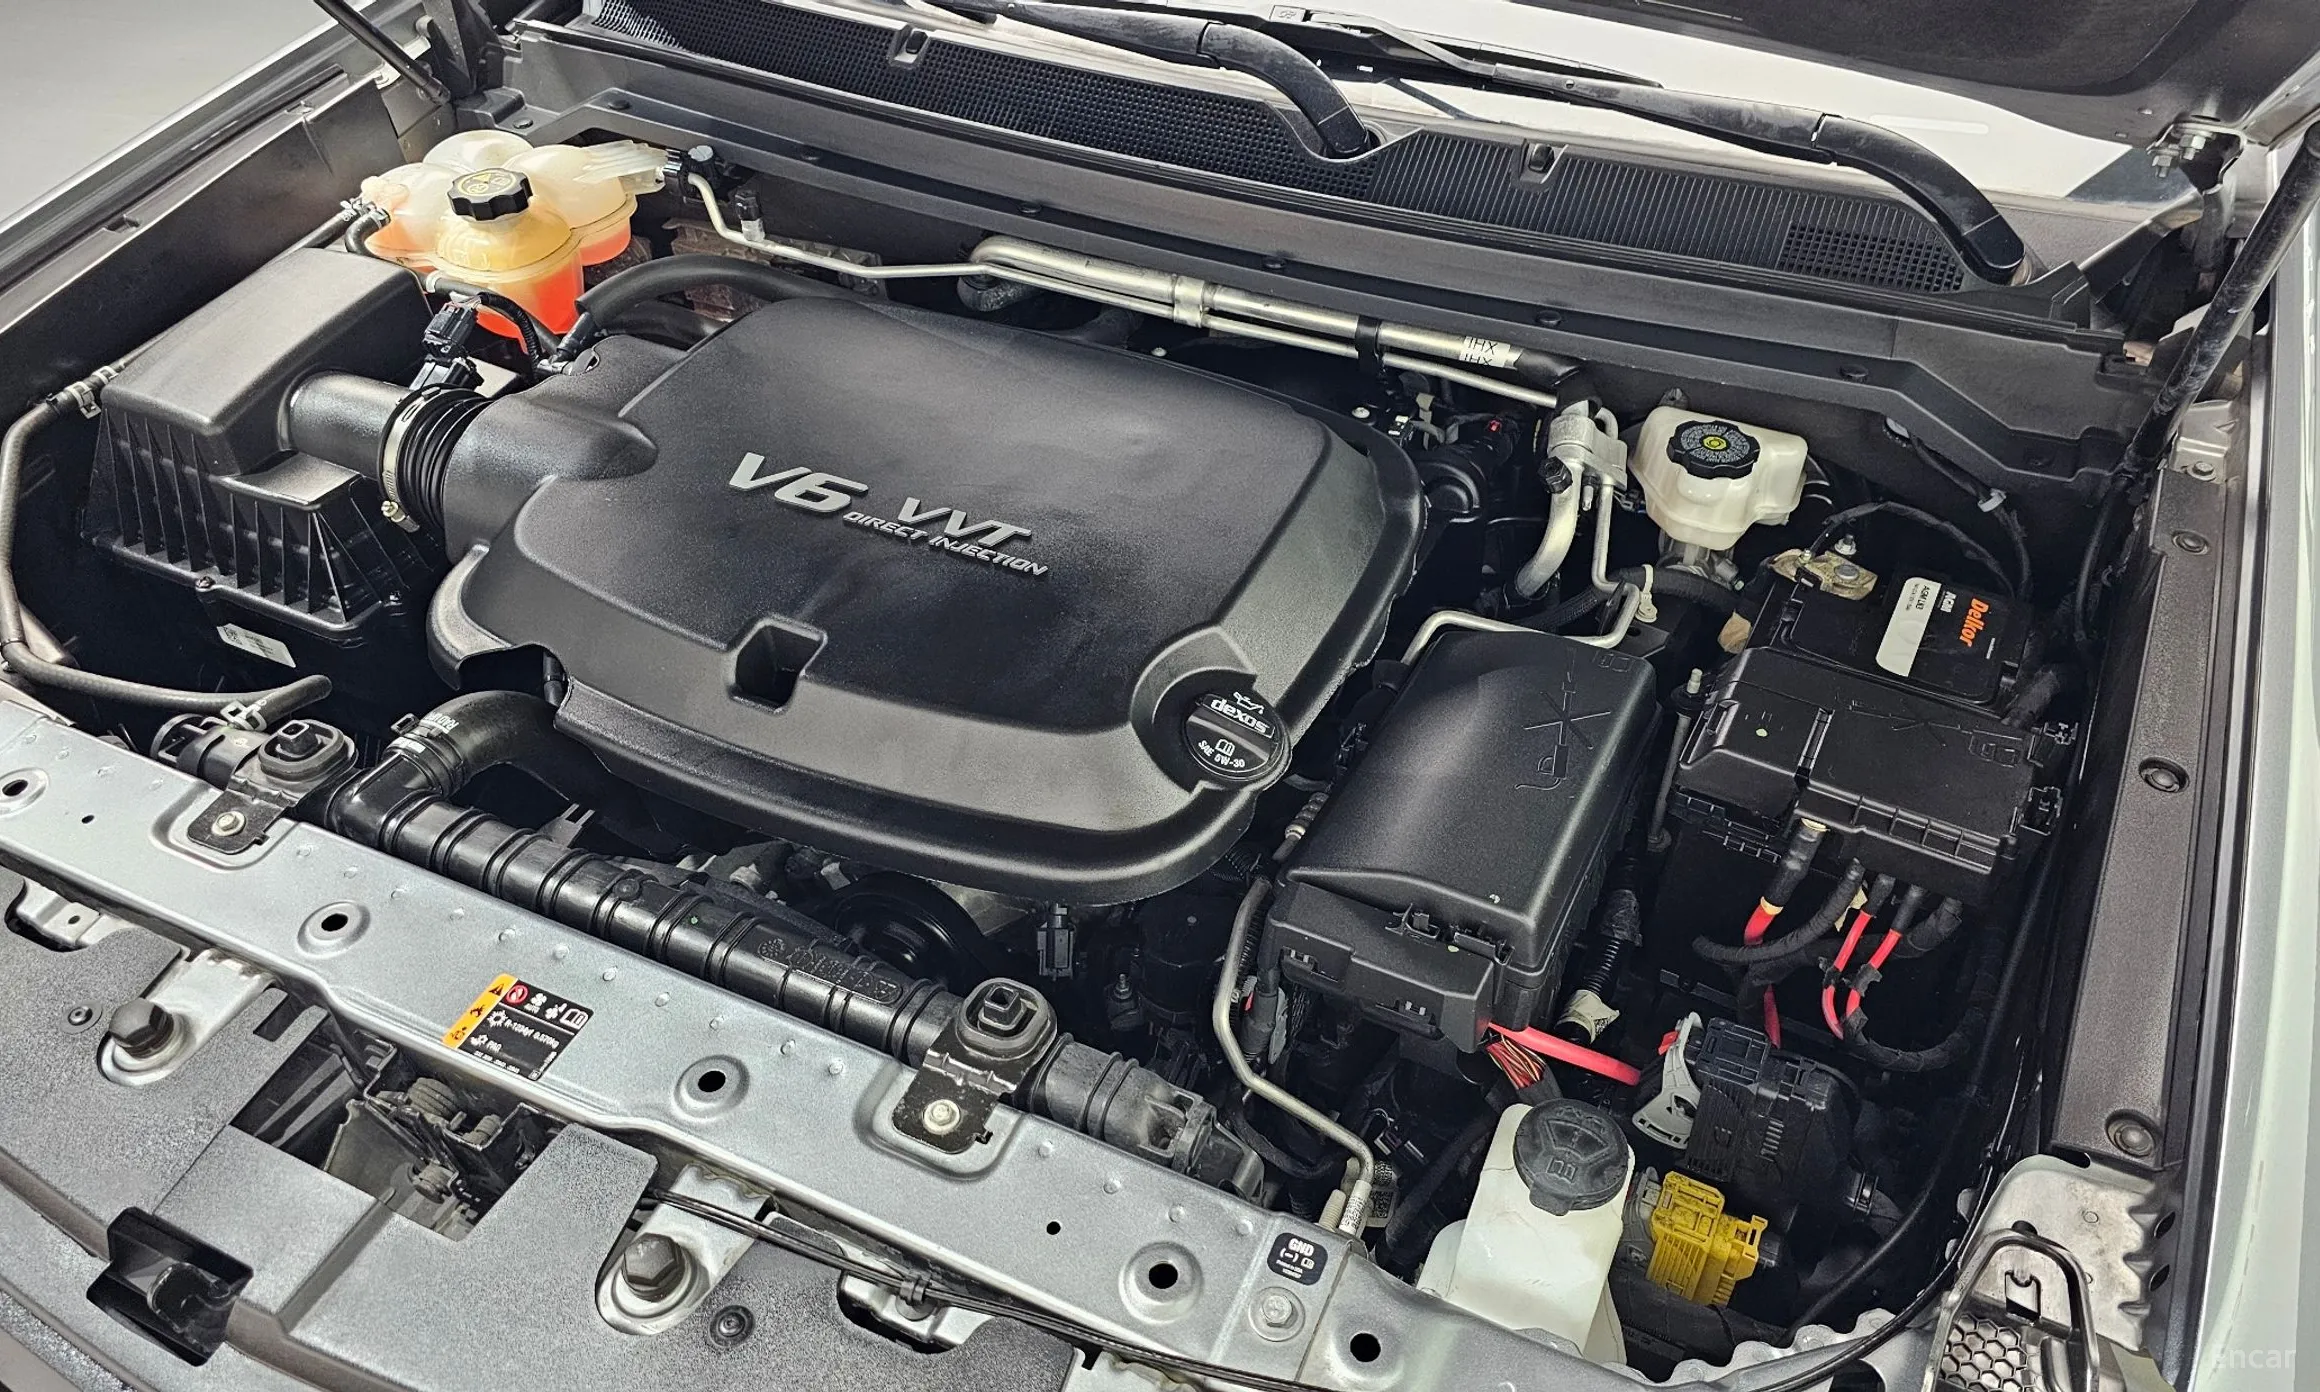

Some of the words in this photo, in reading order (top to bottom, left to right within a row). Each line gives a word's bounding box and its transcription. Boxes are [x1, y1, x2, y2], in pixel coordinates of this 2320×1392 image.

[1468, 336, 1498, 355] IHX
[729, 452, 869, 513] V6
[898, 497, 1032, 547] VVT
[843, 511, 929, 540] DIRECT
[929, 535, 1048, 576] INJECTION
[1960, 598, 1989, 648] Delkor
[1210, 699, 1271, 734] dexos
[1198, 740, 1215, 757] SAE
[1287, 1238, 1315, 1257] GND
